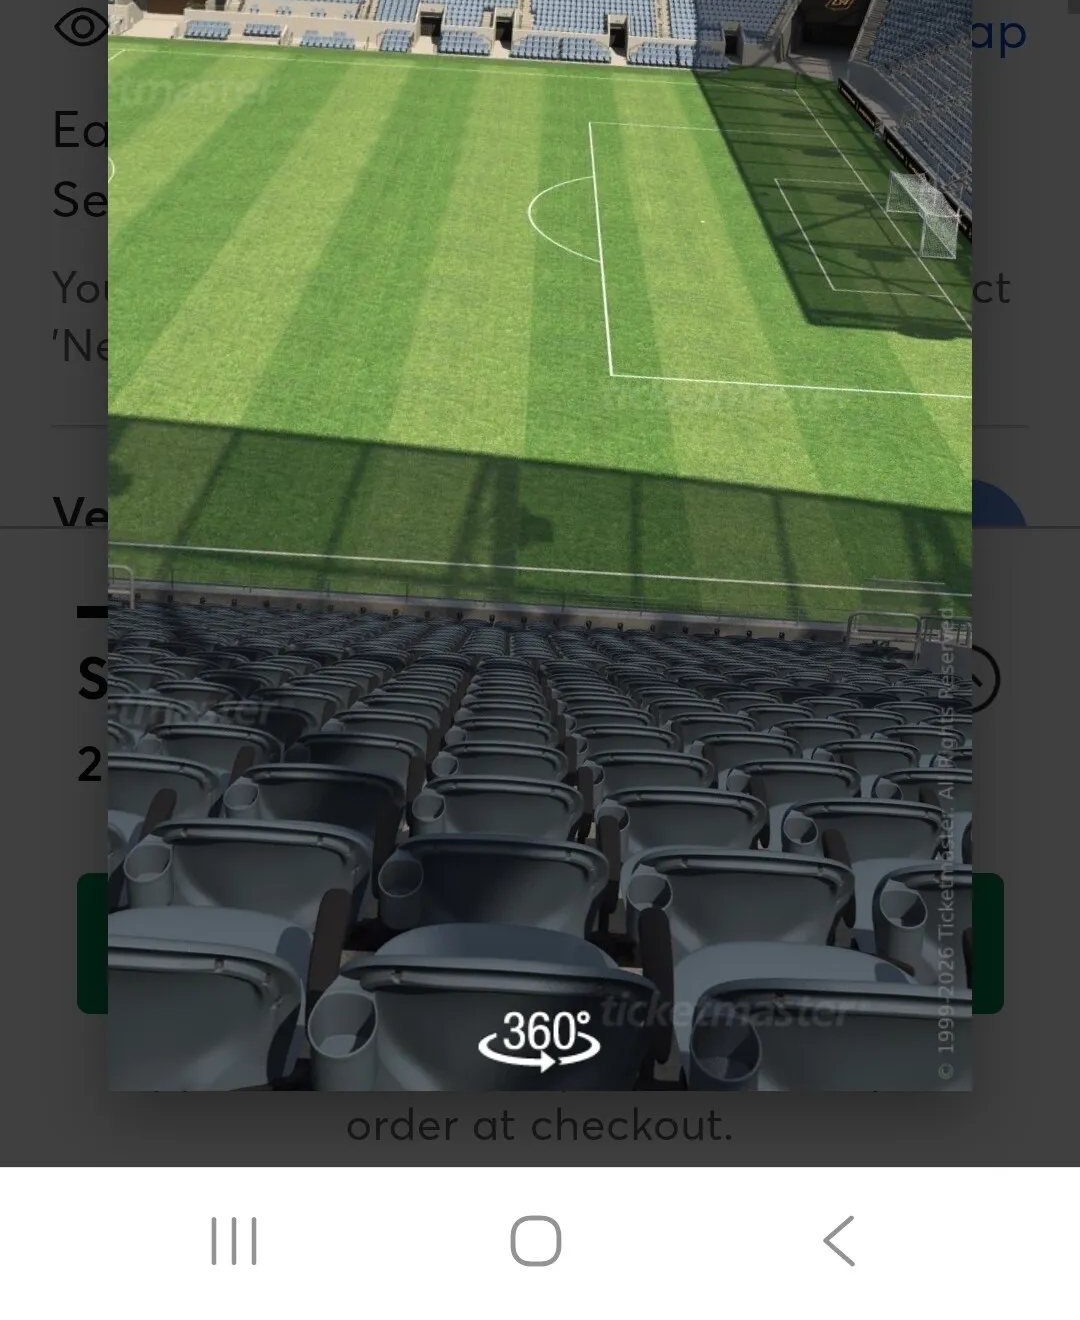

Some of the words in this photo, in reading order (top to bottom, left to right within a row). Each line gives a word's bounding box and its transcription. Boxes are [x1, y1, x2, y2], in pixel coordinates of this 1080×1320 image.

[53, 181, 108, 217] Se
[52, 271, 108, 304] Yo
[347, 1107, 458, 1141] order
[473, 1110, 515, 1141] at
[531, 1107, 732, 1141] checkout.
